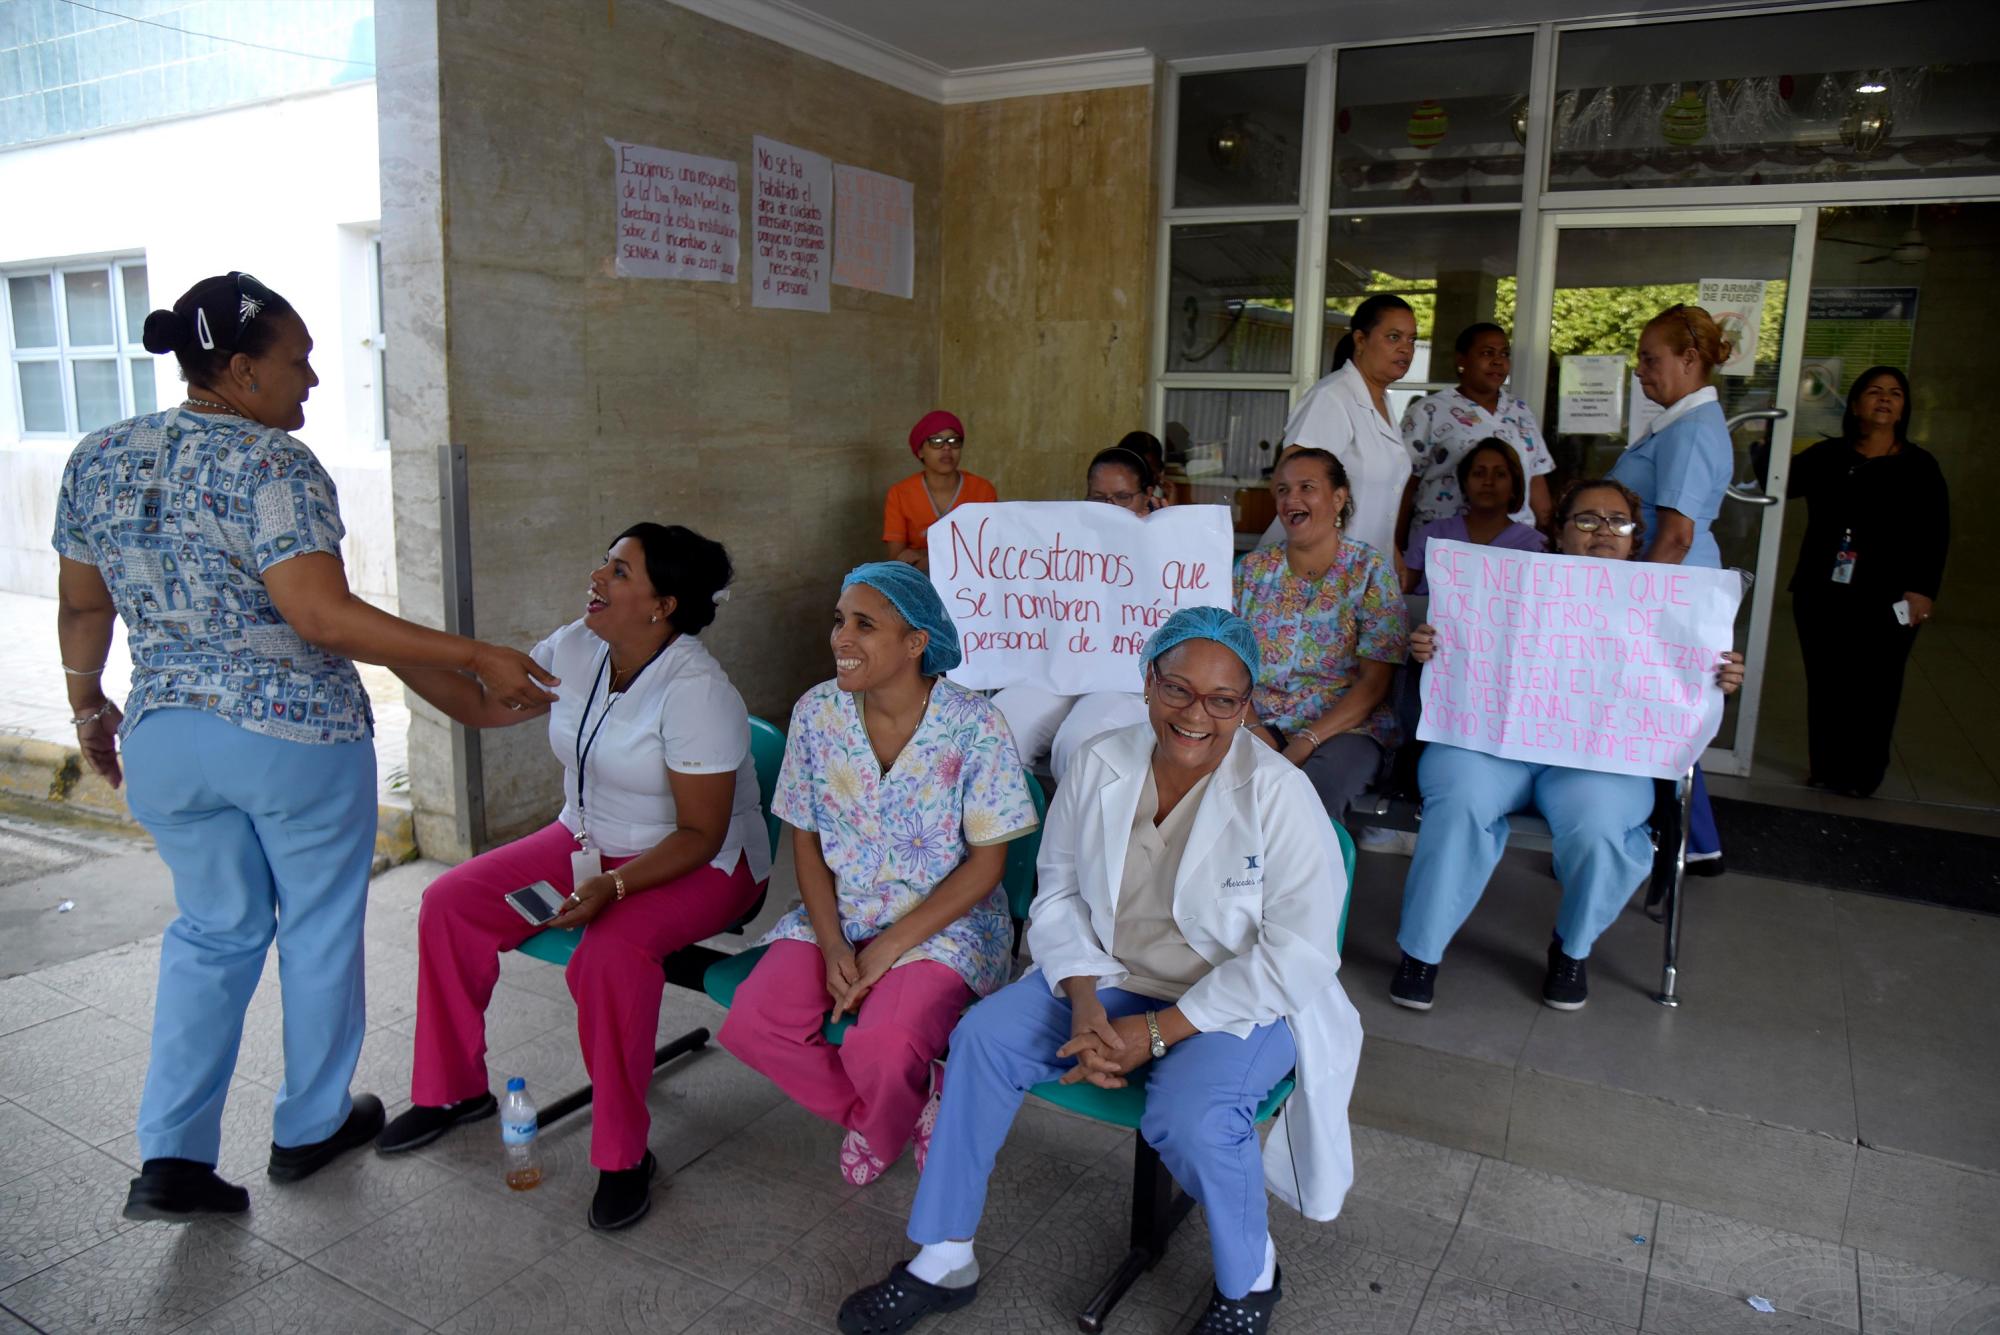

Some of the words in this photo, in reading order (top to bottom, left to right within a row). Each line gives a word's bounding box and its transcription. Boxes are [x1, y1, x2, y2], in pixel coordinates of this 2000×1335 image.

[759, 148, 773, 171] No
[775, 157, 787, 175] se
[790, 155, 803, 179] ha
[623, 180, 636, 199] de
[802, 182, 811, 202] el
[664, 208, 674, 227] de
[651, 227, 659, 243] el
[711, 240, 722, 254] de
[1702, 283, 1719, 292] NO
[1721, 283, 1761, 293] ARMAS
[1702, 293, 1717, 301] DE
[1720, 293, 1760, 303] FUEGO
[949, 517, 1134, 588] Necesitamos
[1162, 559, 1210, 606] que
[1431, 548, 1473, 588] SE
[1483, 556, 1616, 599] NECESITA
[1629, 571, 1692, 606] QUE
[1004, 590, 1100, 623] nombren
[1122, 598, 1171, 628] más
[1432, 588, 1482, 626] LOS
[1488, 596, 1609, 632] CENTROS
[1628, 608, 1664, 637] DE
[963, 628, 1049, 664] personal
[1069, 628, 1097, 653] de
[1111, 631, 1145, 655] enfe
[1464, 658, 1559, 691] NIVELEN
[1570, 669, 1604, 696] EL
[1612, 672, 1703, 707] SUELDO
[1430, 676, 1456, 706] AL
[1470, 687, 1580, 723] PERSONAL
[1590, 701, 1617, 729] DE
[1627, 705, 1704, 739] SALUD
[1424, 702, 1480, 737] COMO
[1487, 717, 1514, 745] SE
[1522, 720, 1563, 750] LES
[1572, 726, 1695, 773] PROMETIO
